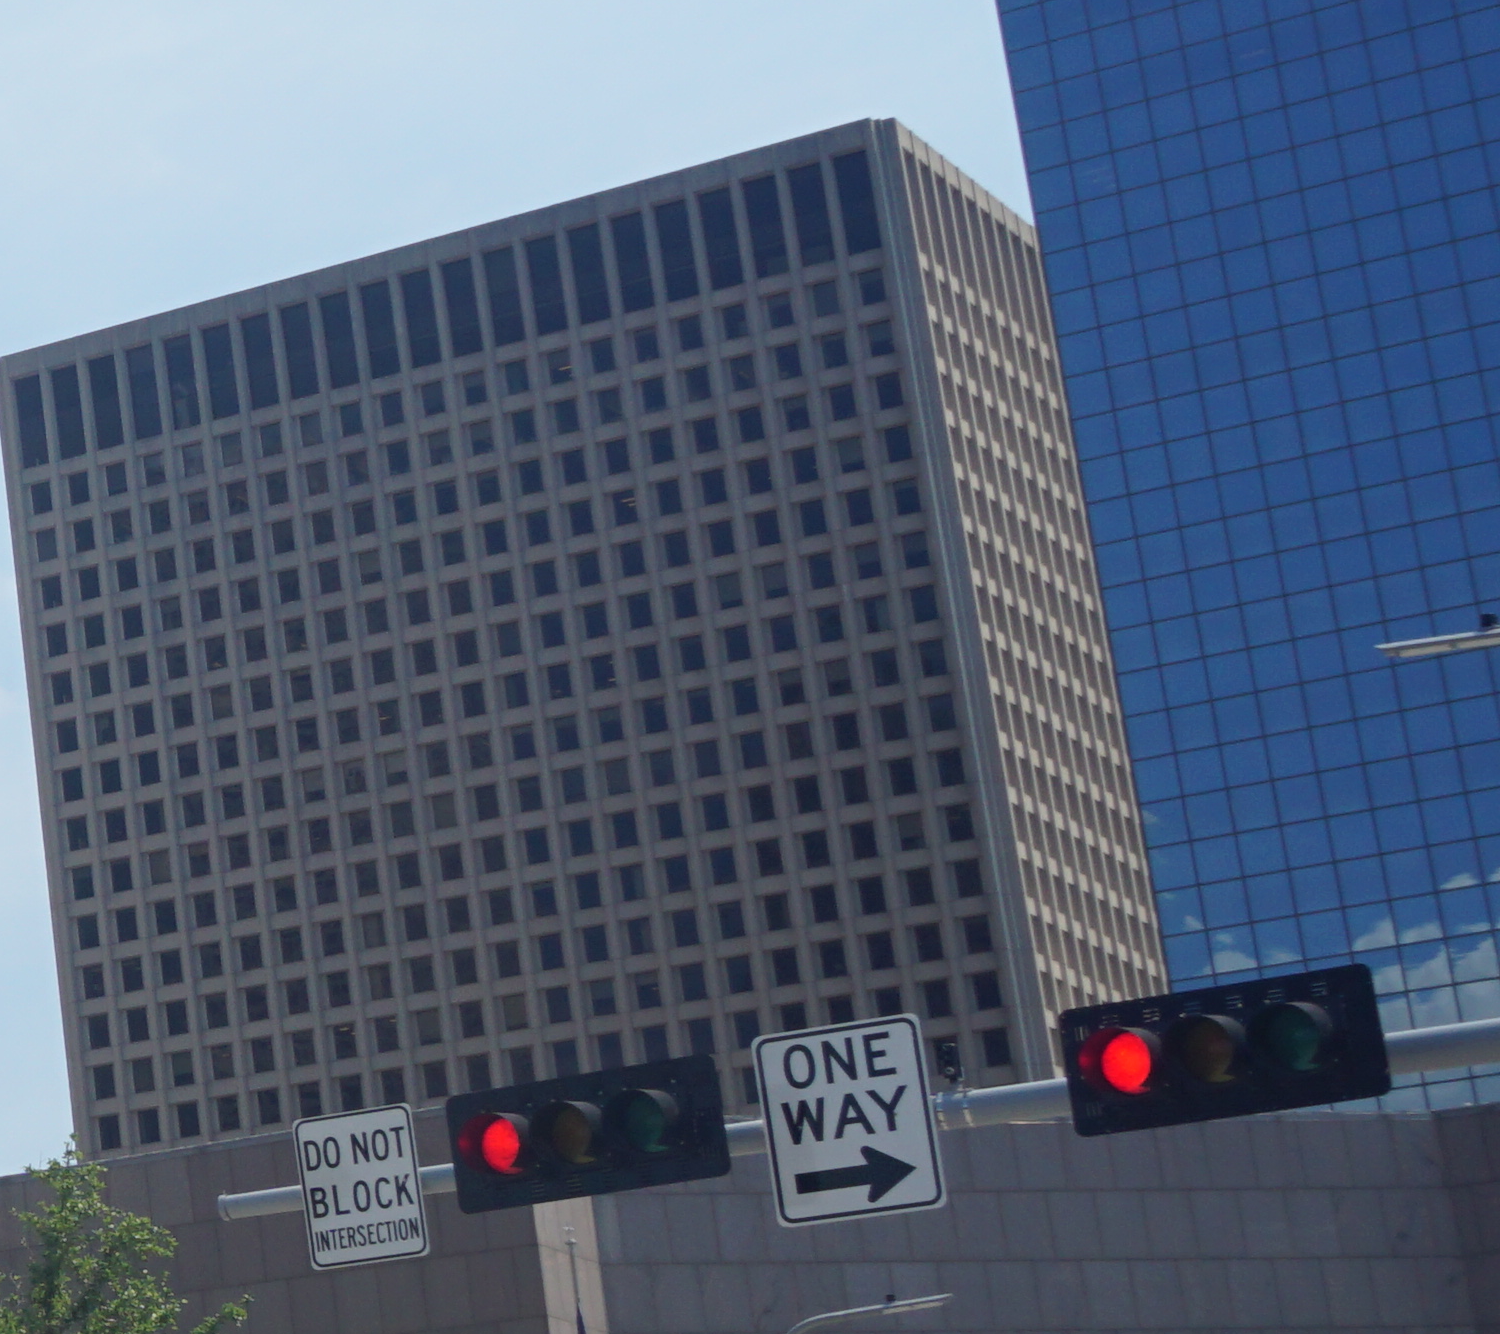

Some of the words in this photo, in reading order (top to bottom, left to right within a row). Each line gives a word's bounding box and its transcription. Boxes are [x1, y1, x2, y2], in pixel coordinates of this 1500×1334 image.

[783, 1031, 897, 1089] ONE
[780, 1085, 907, 1145] WAY
[303, 1136, 341, 1171] DO
[350, 1126, 404, 1164] NOT
[309, 1173, 414, 1218] BLOCK
[314, 1217, 420, 1252] INTERSECTION
